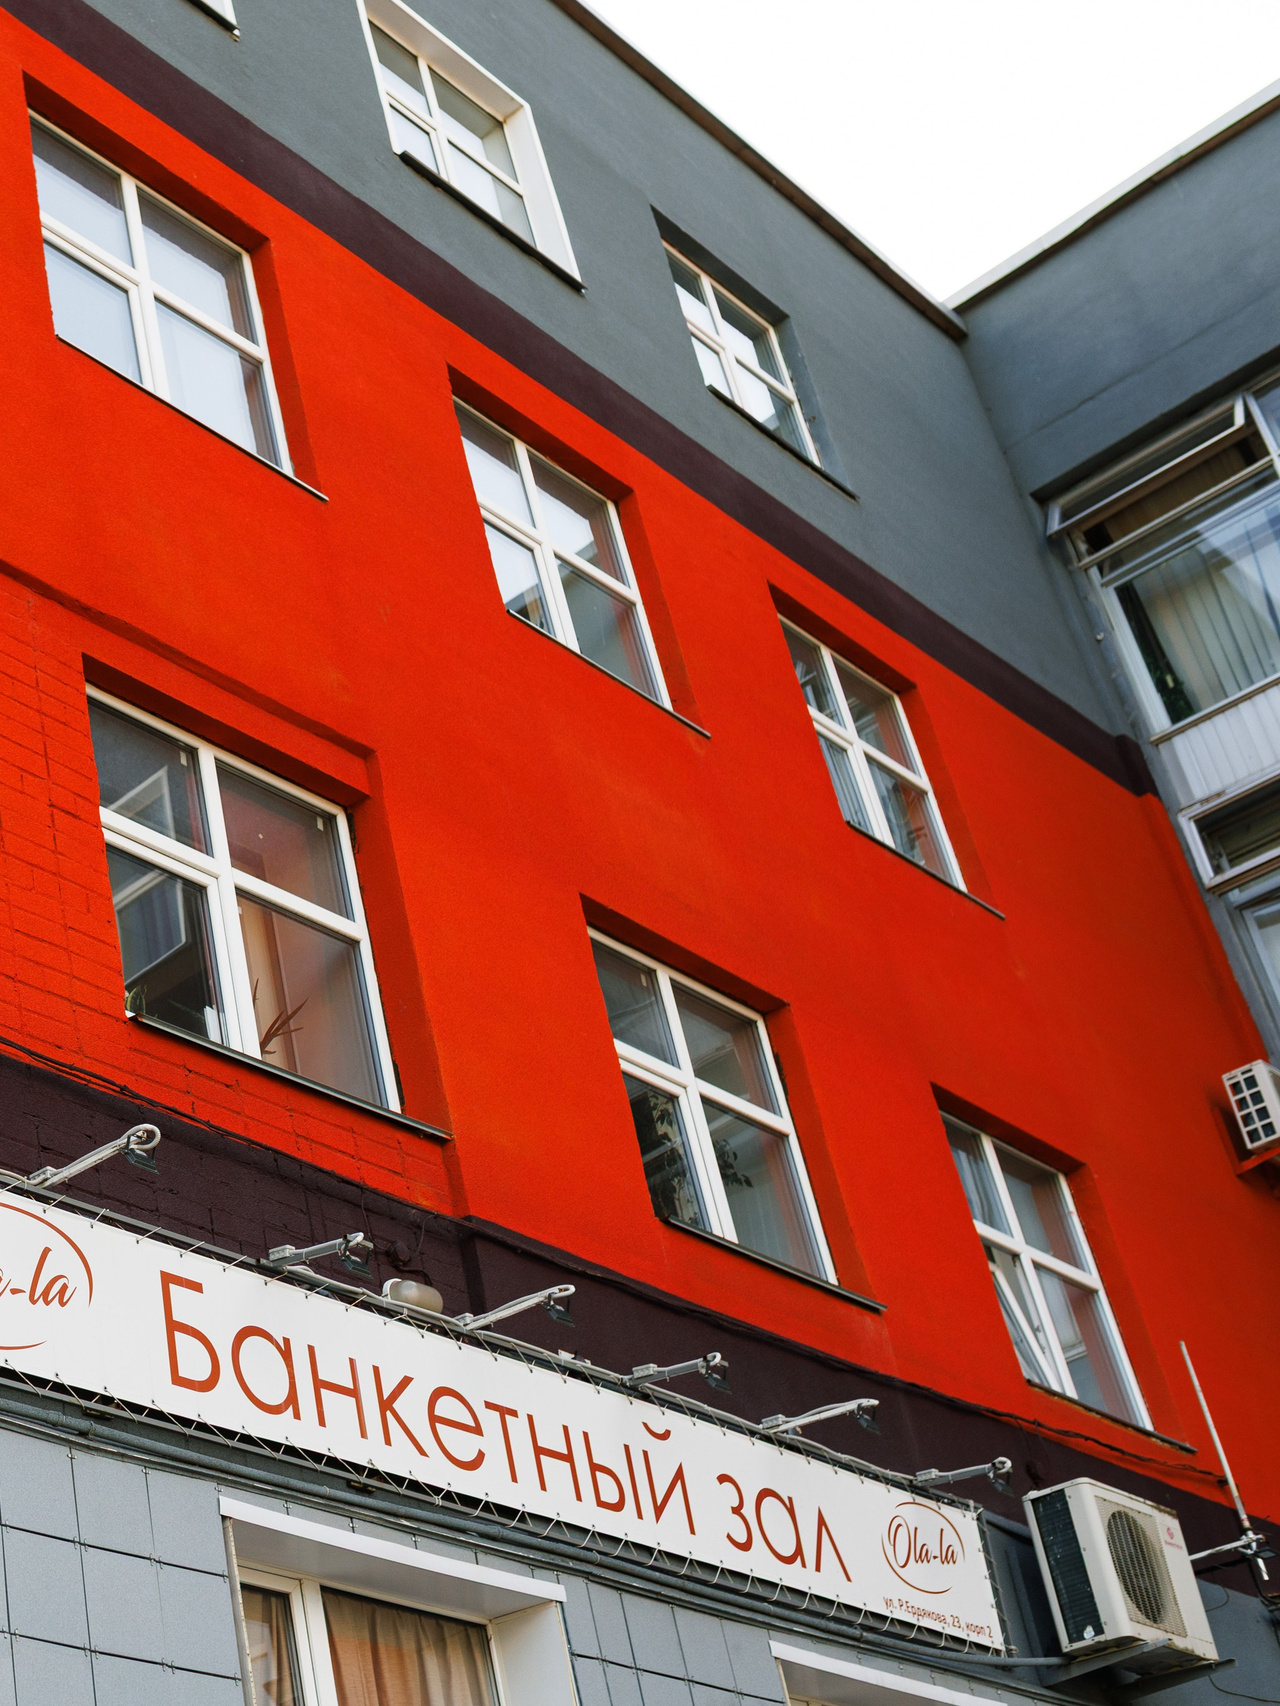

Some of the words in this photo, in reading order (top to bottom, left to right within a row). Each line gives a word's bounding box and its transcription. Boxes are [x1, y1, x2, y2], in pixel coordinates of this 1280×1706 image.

[160, 1270, 697, 1535] Банкетный
[716, 1473, 852, 1583] зал
[887, 1515, 958, 1569] Ola-la
[883, 1596, 897, 1610] ул.
[986, 1625, 994, 1639] 2
